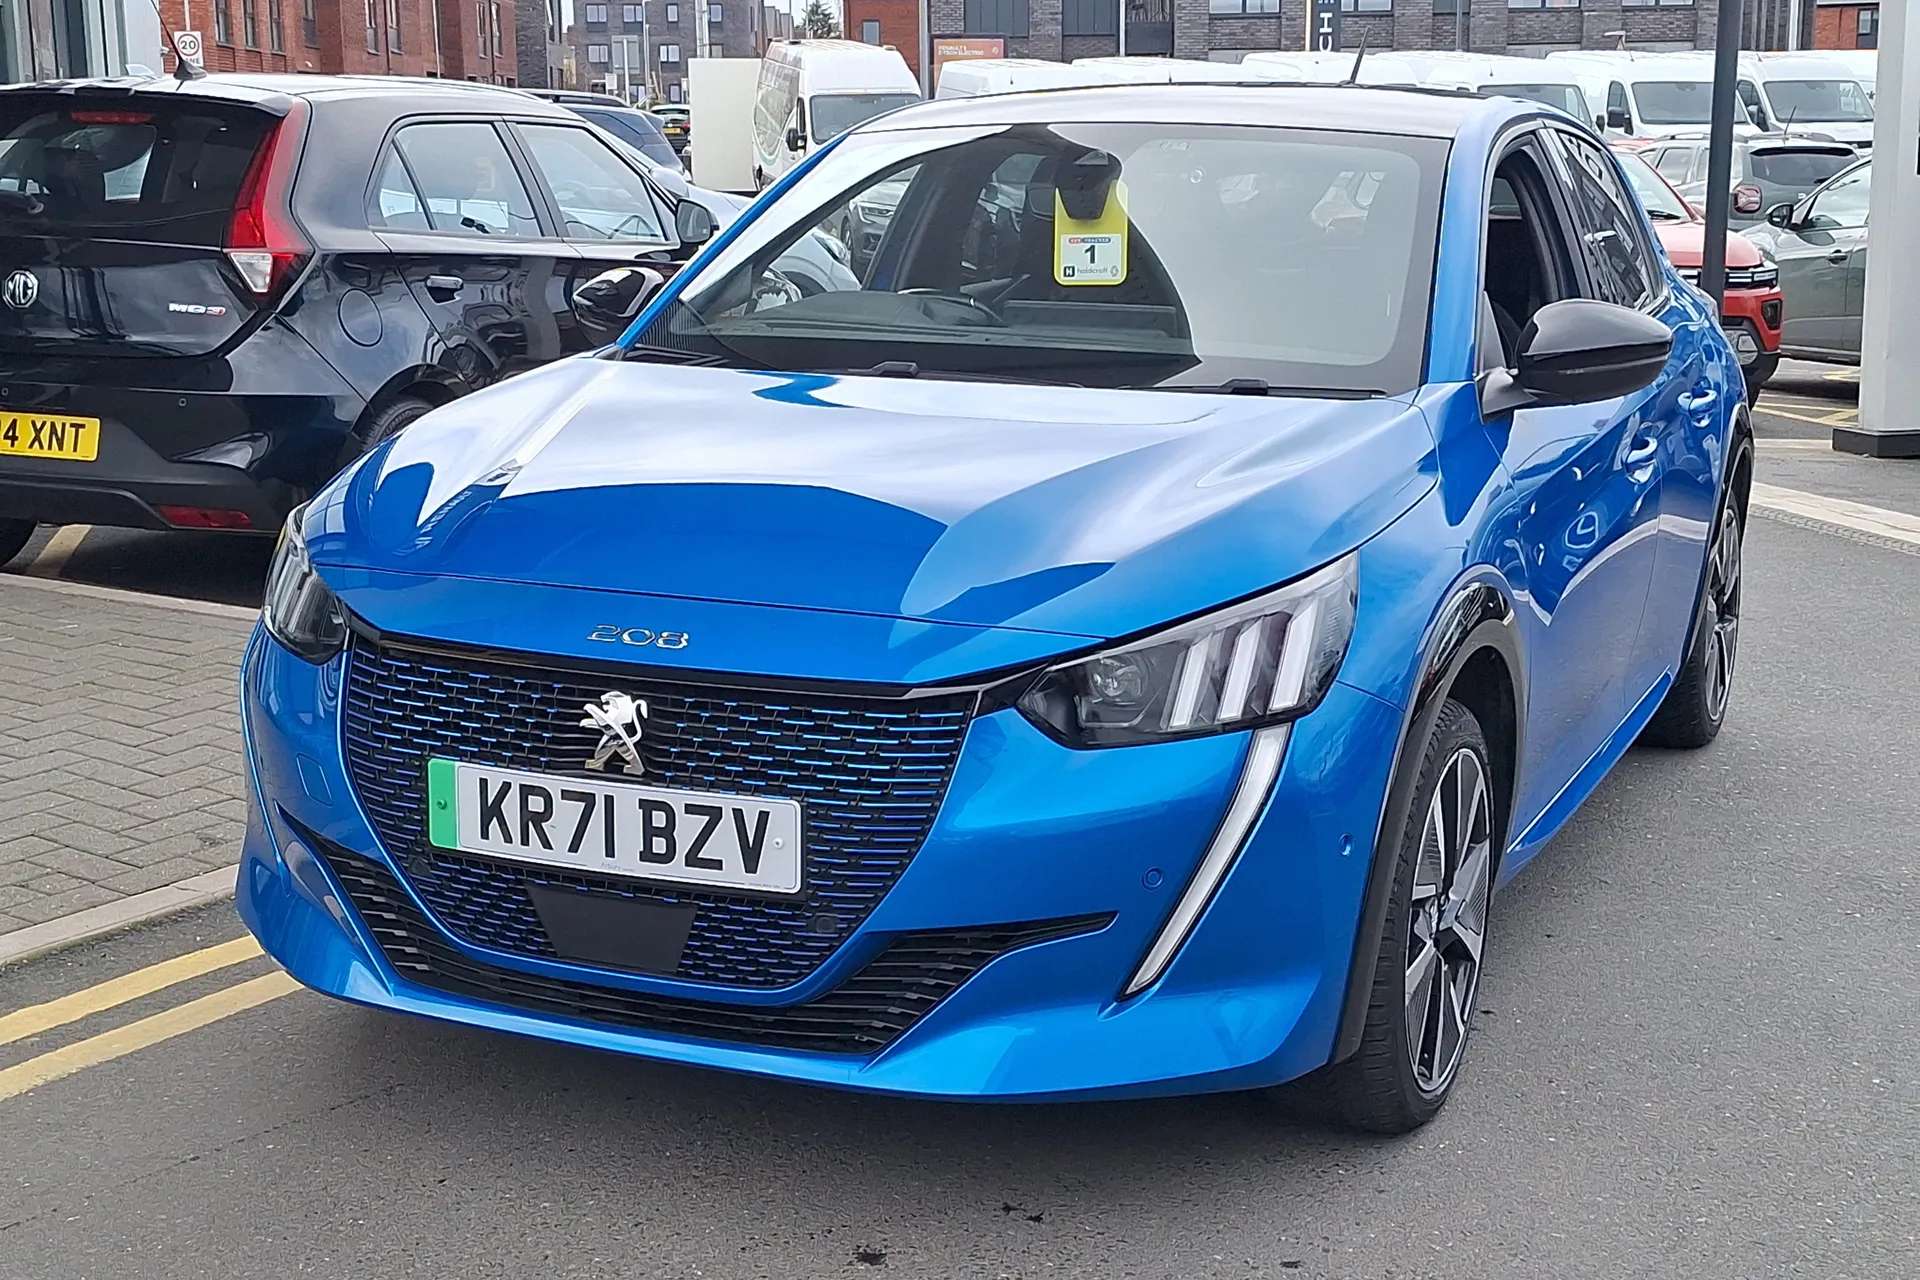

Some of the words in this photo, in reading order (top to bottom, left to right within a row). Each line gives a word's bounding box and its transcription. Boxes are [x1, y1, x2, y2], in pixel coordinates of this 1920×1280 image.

[1319, 0, 1333, 52] CH
[181, 40, 196, 50] 20
[1084, 245, 1095, 264] 1
[8, 273, 33, 304] MG
[0, 418, 19, 448] 4
[28, 419, 86, 453] XNT
[586, 624, 689, 649] 208
[478, 777, 616, 859] KR71
[637, 797, 770, 875] BZV
